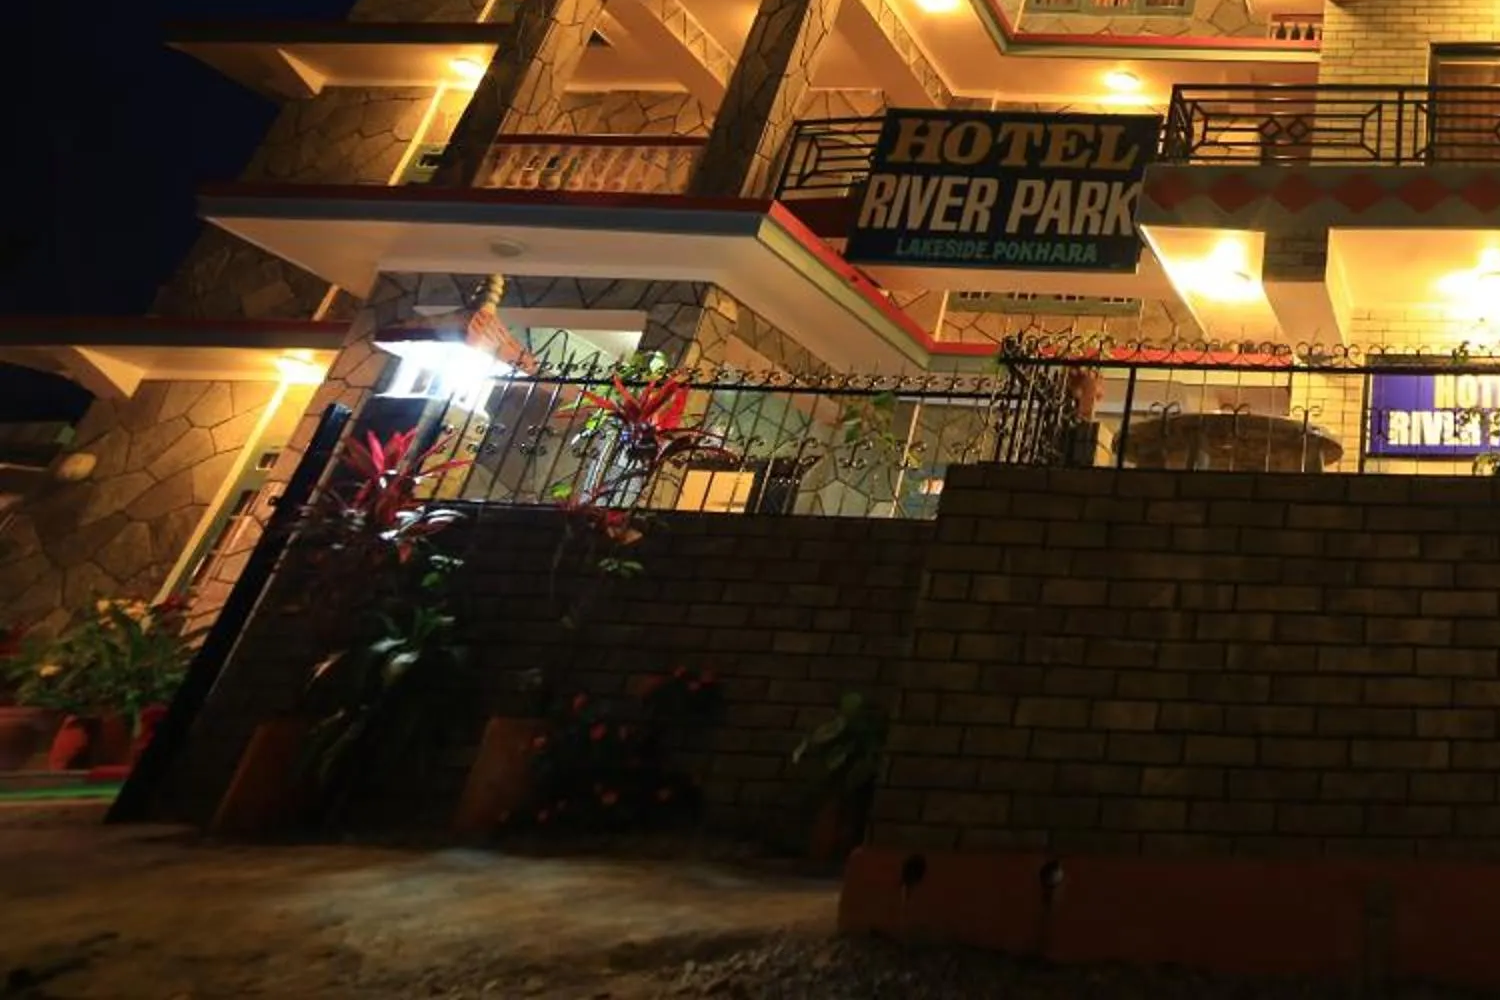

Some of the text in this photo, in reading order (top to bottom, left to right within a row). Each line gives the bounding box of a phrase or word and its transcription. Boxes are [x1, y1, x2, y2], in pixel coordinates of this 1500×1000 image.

[886, 117, 1140, 171] HOTEL
[857, 173, 1143, 237] RIVER PARK
[991, 241, 1097, 263] POKHARA
